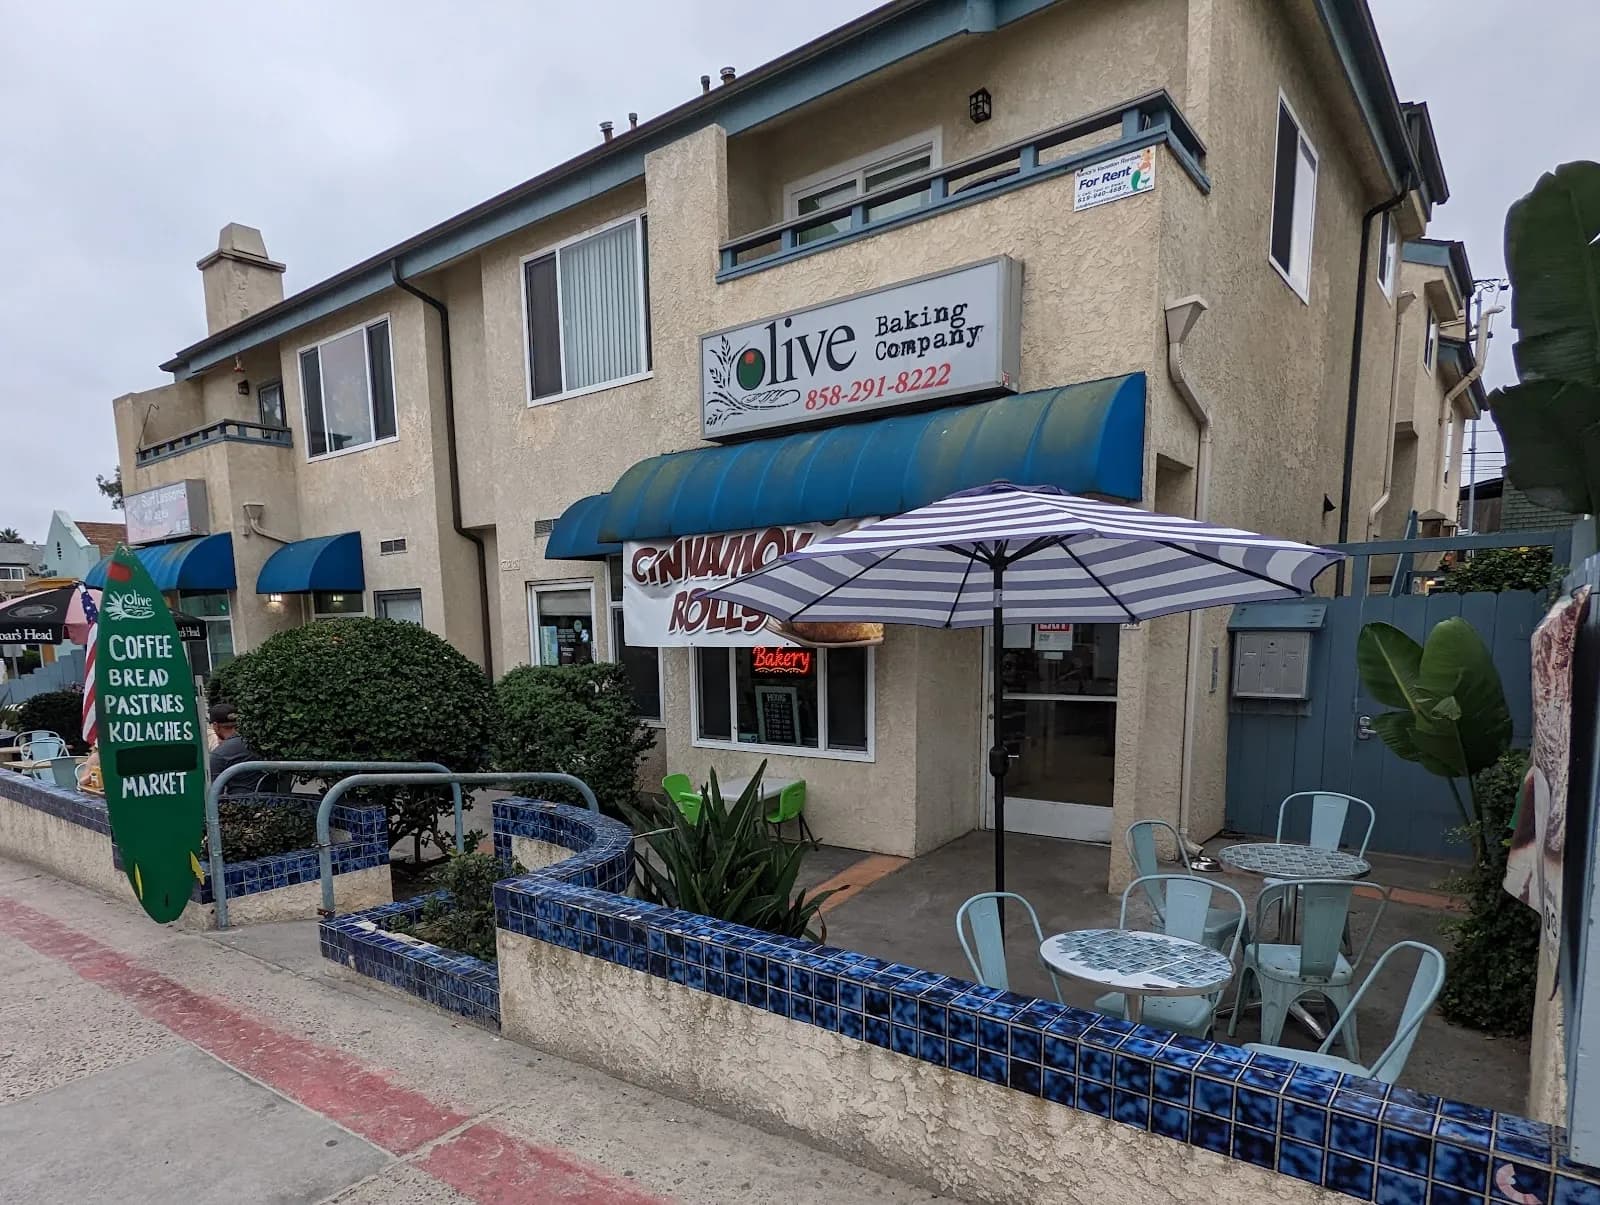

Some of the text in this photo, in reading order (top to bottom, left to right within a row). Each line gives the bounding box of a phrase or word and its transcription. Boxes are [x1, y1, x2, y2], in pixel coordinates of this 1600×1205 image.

[1079, 176, 1100, 191] For
[1102, 166, 1132, 184] Rent
[875, 303, 968, 337] Baking
[875, 325, 984, 361] Company
[805, 363, 952, 411] 858-291-8222
[0, 629, 53, 640] oar's Head
[109, 634, 173, 661] COFFEE
[752, 645, 810, 672] Bakery
[109, 668, 169, 687] BREAD
[104, 694, 185, 716] PASTRIES
[108, 721, 194, 743] KOLACHES
[122, 771, 188, 799] MARKET
